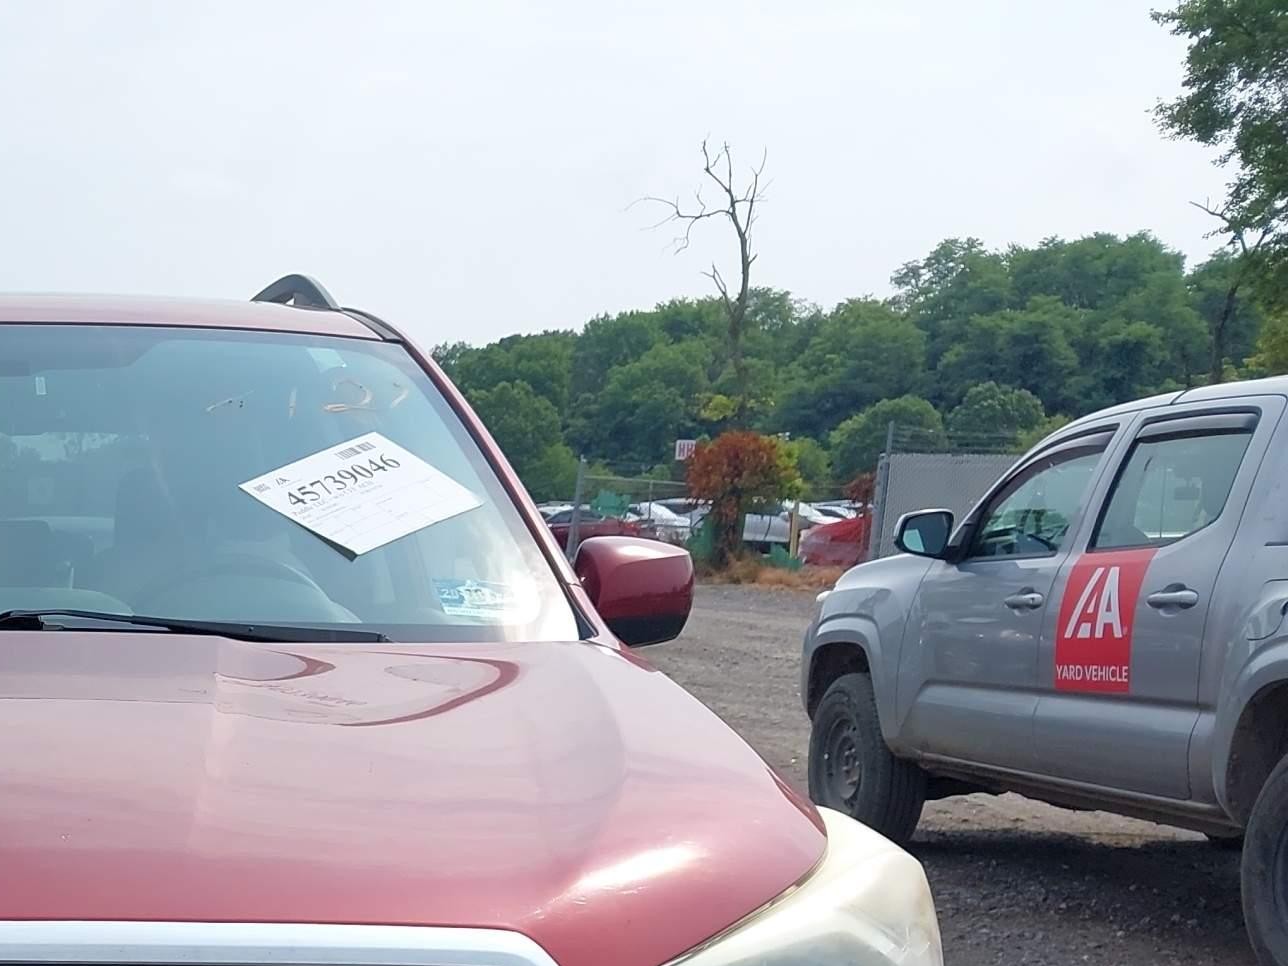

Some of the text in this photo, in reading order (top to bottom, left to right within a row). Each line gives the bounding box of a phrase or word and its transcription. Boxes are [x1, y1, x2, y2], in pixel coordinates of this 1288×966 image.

[287, 453, 401, 506] 45739046
[1056, 664, 1129, 682] YARD VEHICLE
